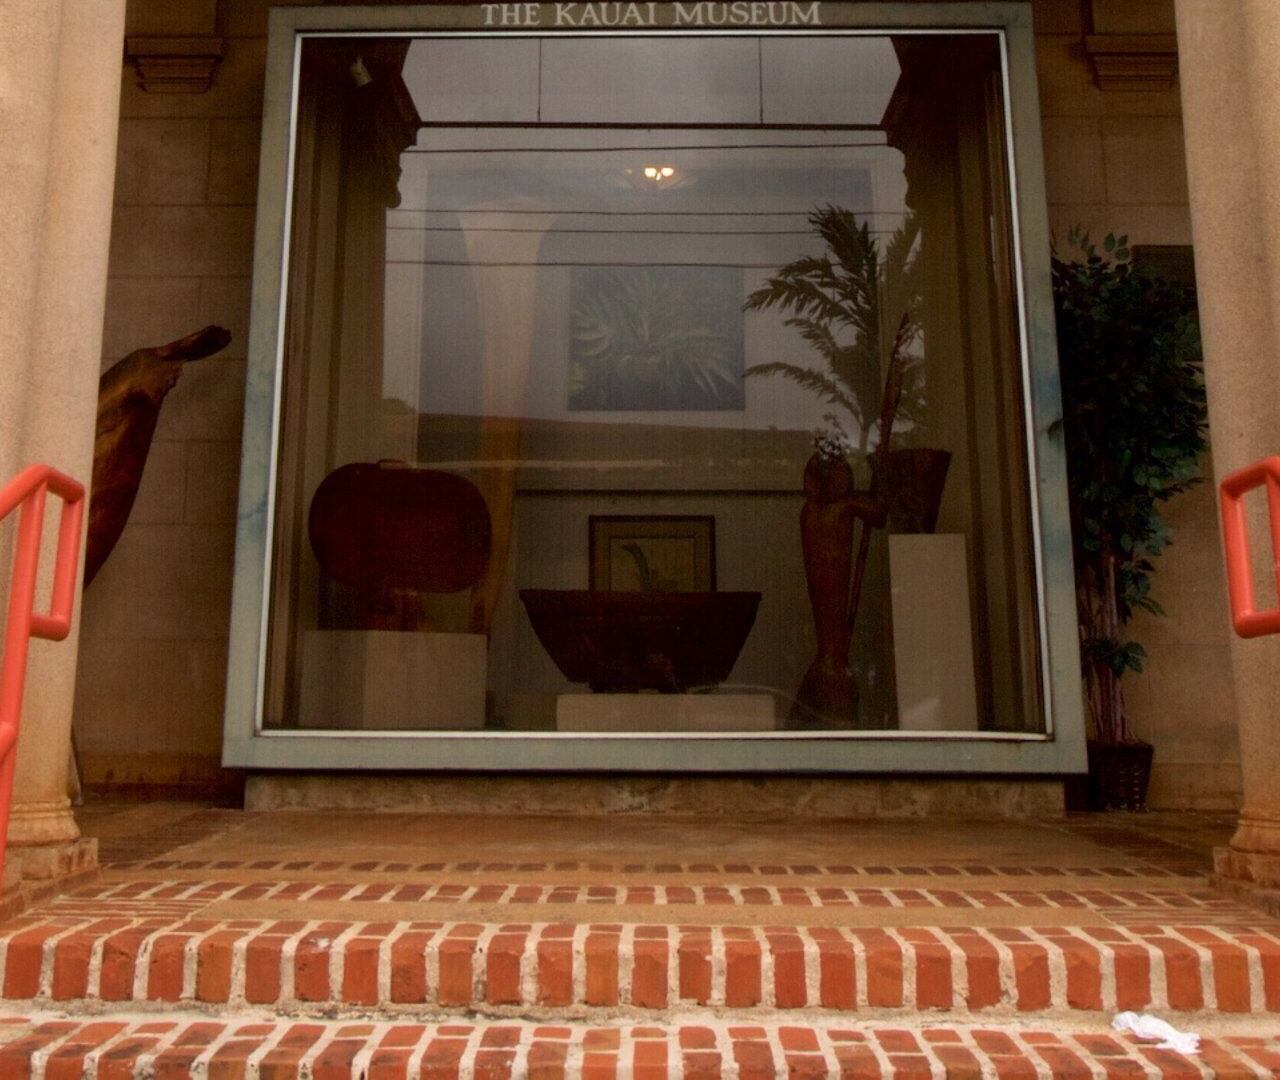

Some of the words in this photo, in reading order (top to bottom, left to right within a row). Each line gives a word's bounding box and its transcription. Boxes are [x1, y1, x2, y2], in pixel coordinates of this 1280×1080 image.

[480, 2, 541, 26] THE
[553, 1, 658, 26] KAUAI
[671, 0, 822, 26] MUSEUM
